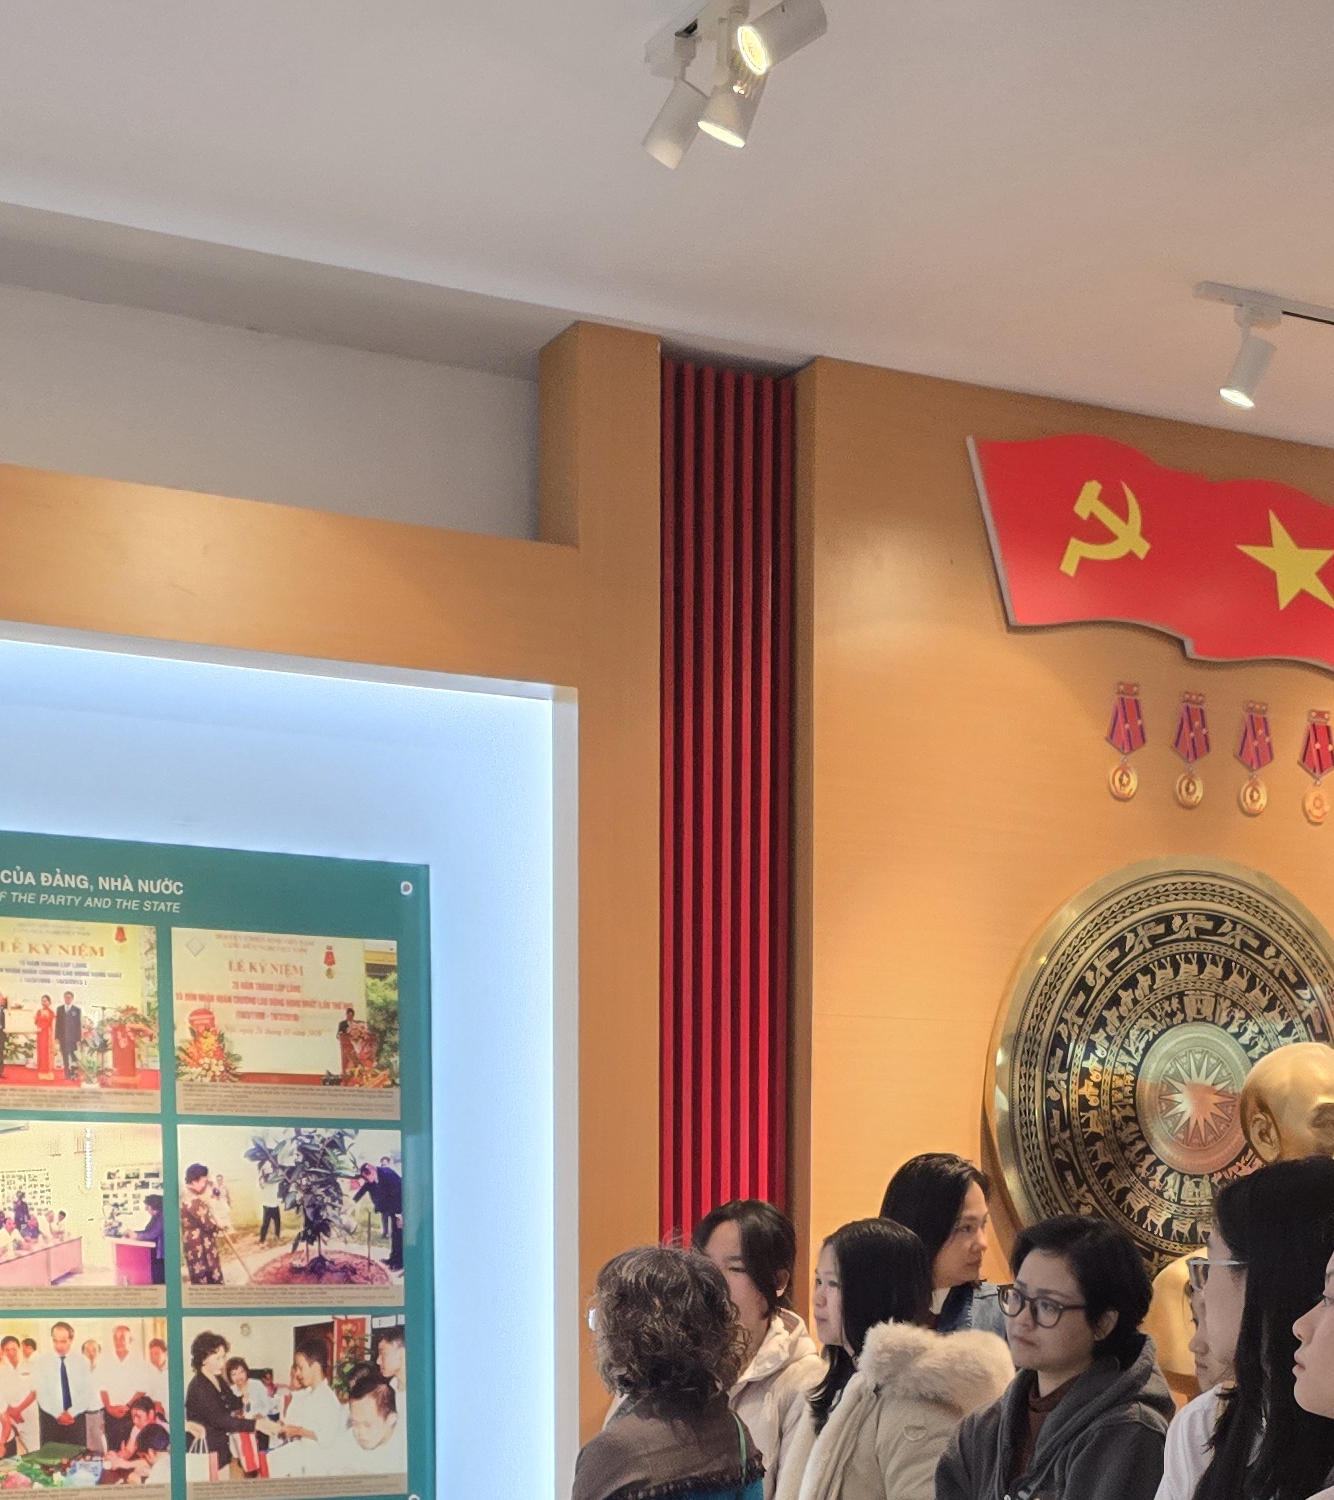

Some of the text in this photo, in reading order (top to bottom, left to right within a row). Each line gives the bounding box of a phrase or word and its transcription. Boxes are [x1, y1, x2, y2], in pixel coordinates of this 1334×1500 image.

[0, 865, 36, 885] CỦA
[40, 868, 94, 892] ĐẢNG,
[98, 874, 134, 892] NHÀ
[137, 877, 184, 895] NƯỚC
[10, 892, 36, 904] THE
[39, 894, 81, 907] PARTY
[84, 897, 112, 908] AND
[115, 898, 140, 911] THE
[142, 900, 181, 913] STATE
